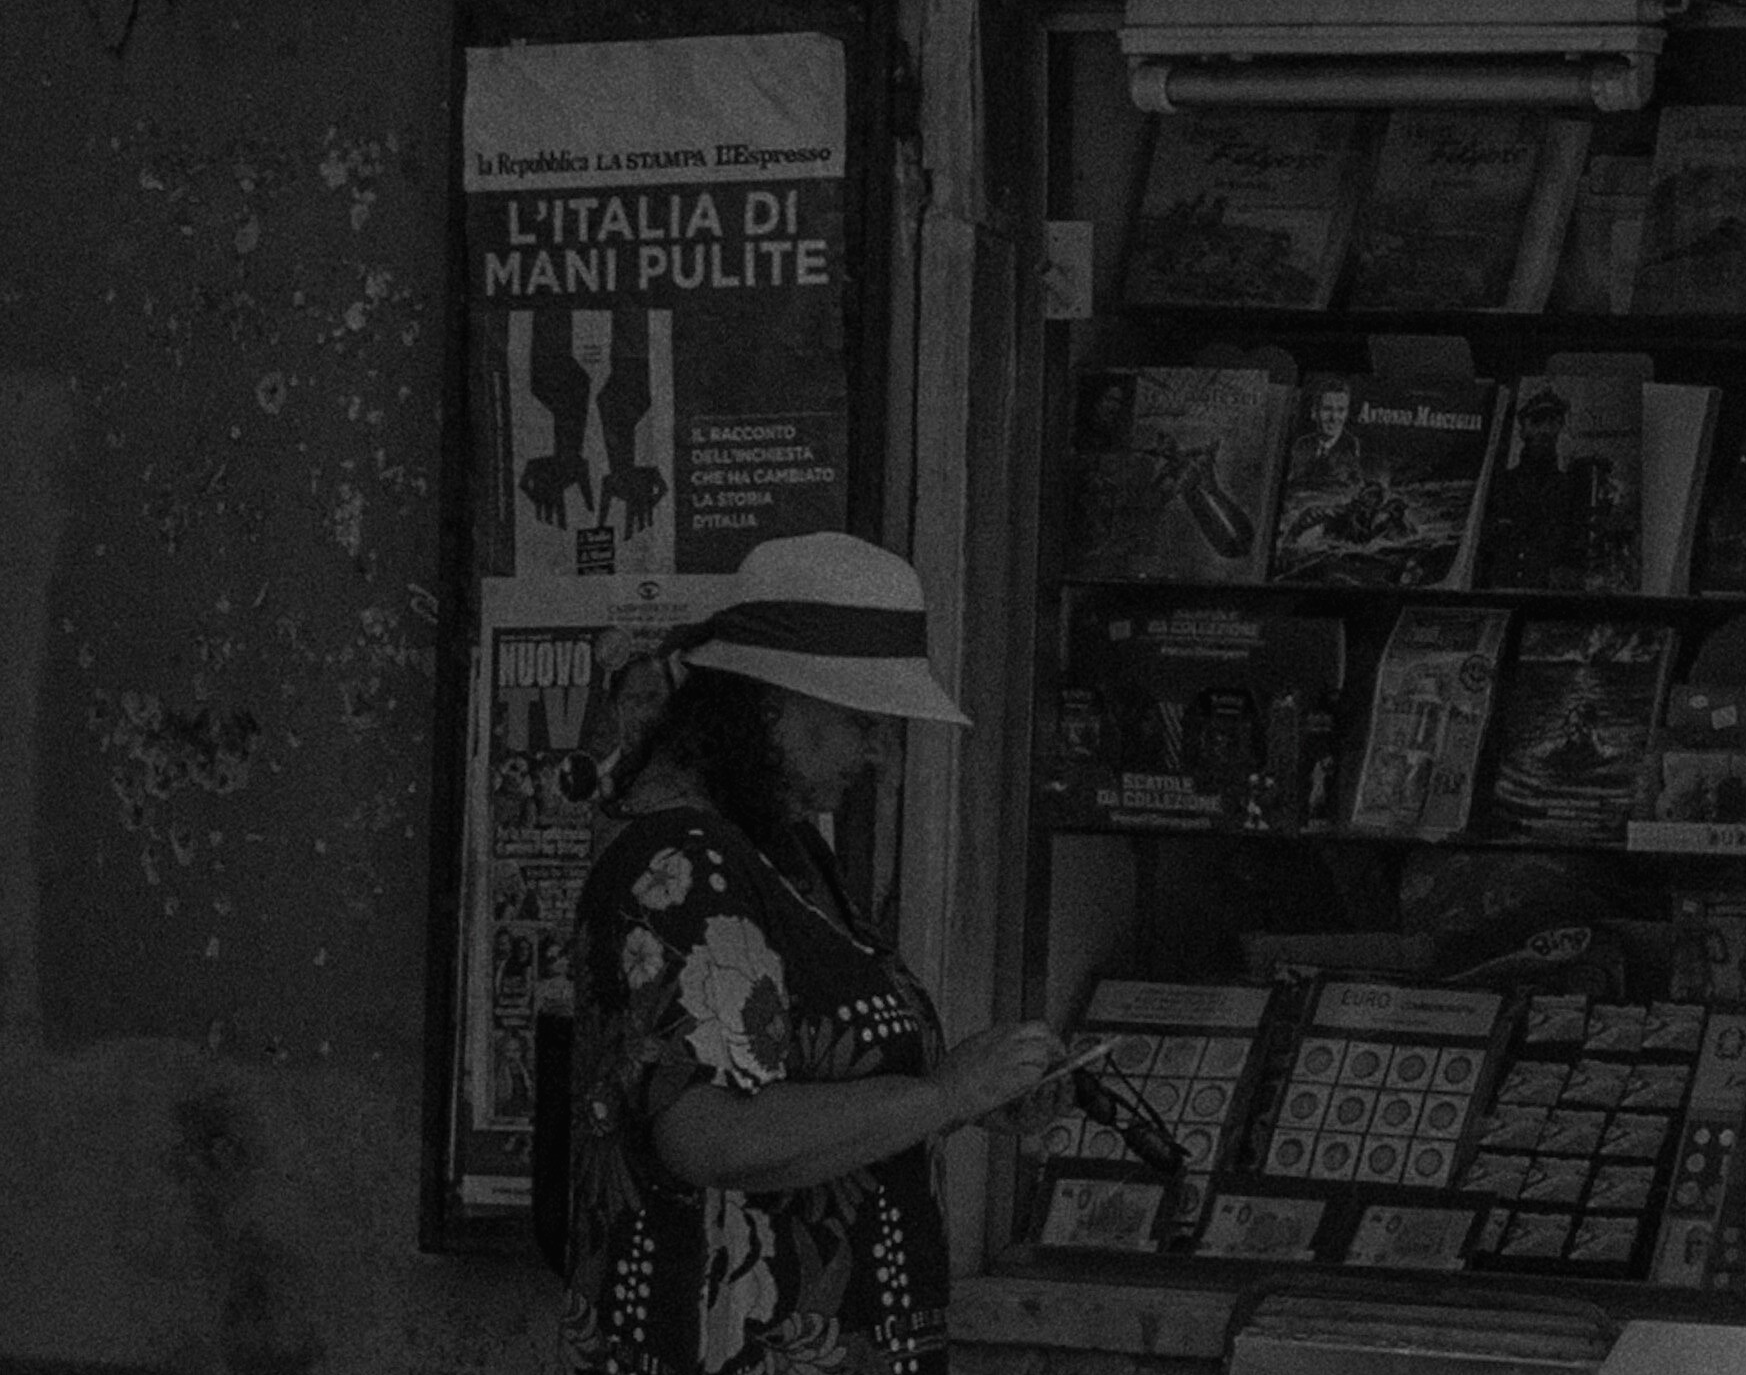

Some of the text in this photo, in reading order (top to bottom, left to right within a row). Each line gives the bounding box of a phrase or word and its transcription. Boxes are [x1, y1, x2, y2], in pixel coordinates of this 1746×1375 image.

[499, 150, 589, 178] Repubblica
[597, 154, 623, 172] LA
[627, 150, 707, 170] STAMPA
[715, 145, 832, 169] L'Espresso
[508, 191, 797, 245] L'ITALIA DI
[485, 241, 829, 297] MANI PULITE
[712, 424, 796, 444] RACCONTO
[692, 466, 834, 486] CHE HA CAMBIATO
[692, 490, 773, 508] LA STORIA
[692, 513, 758, 529] D'ITALIA
